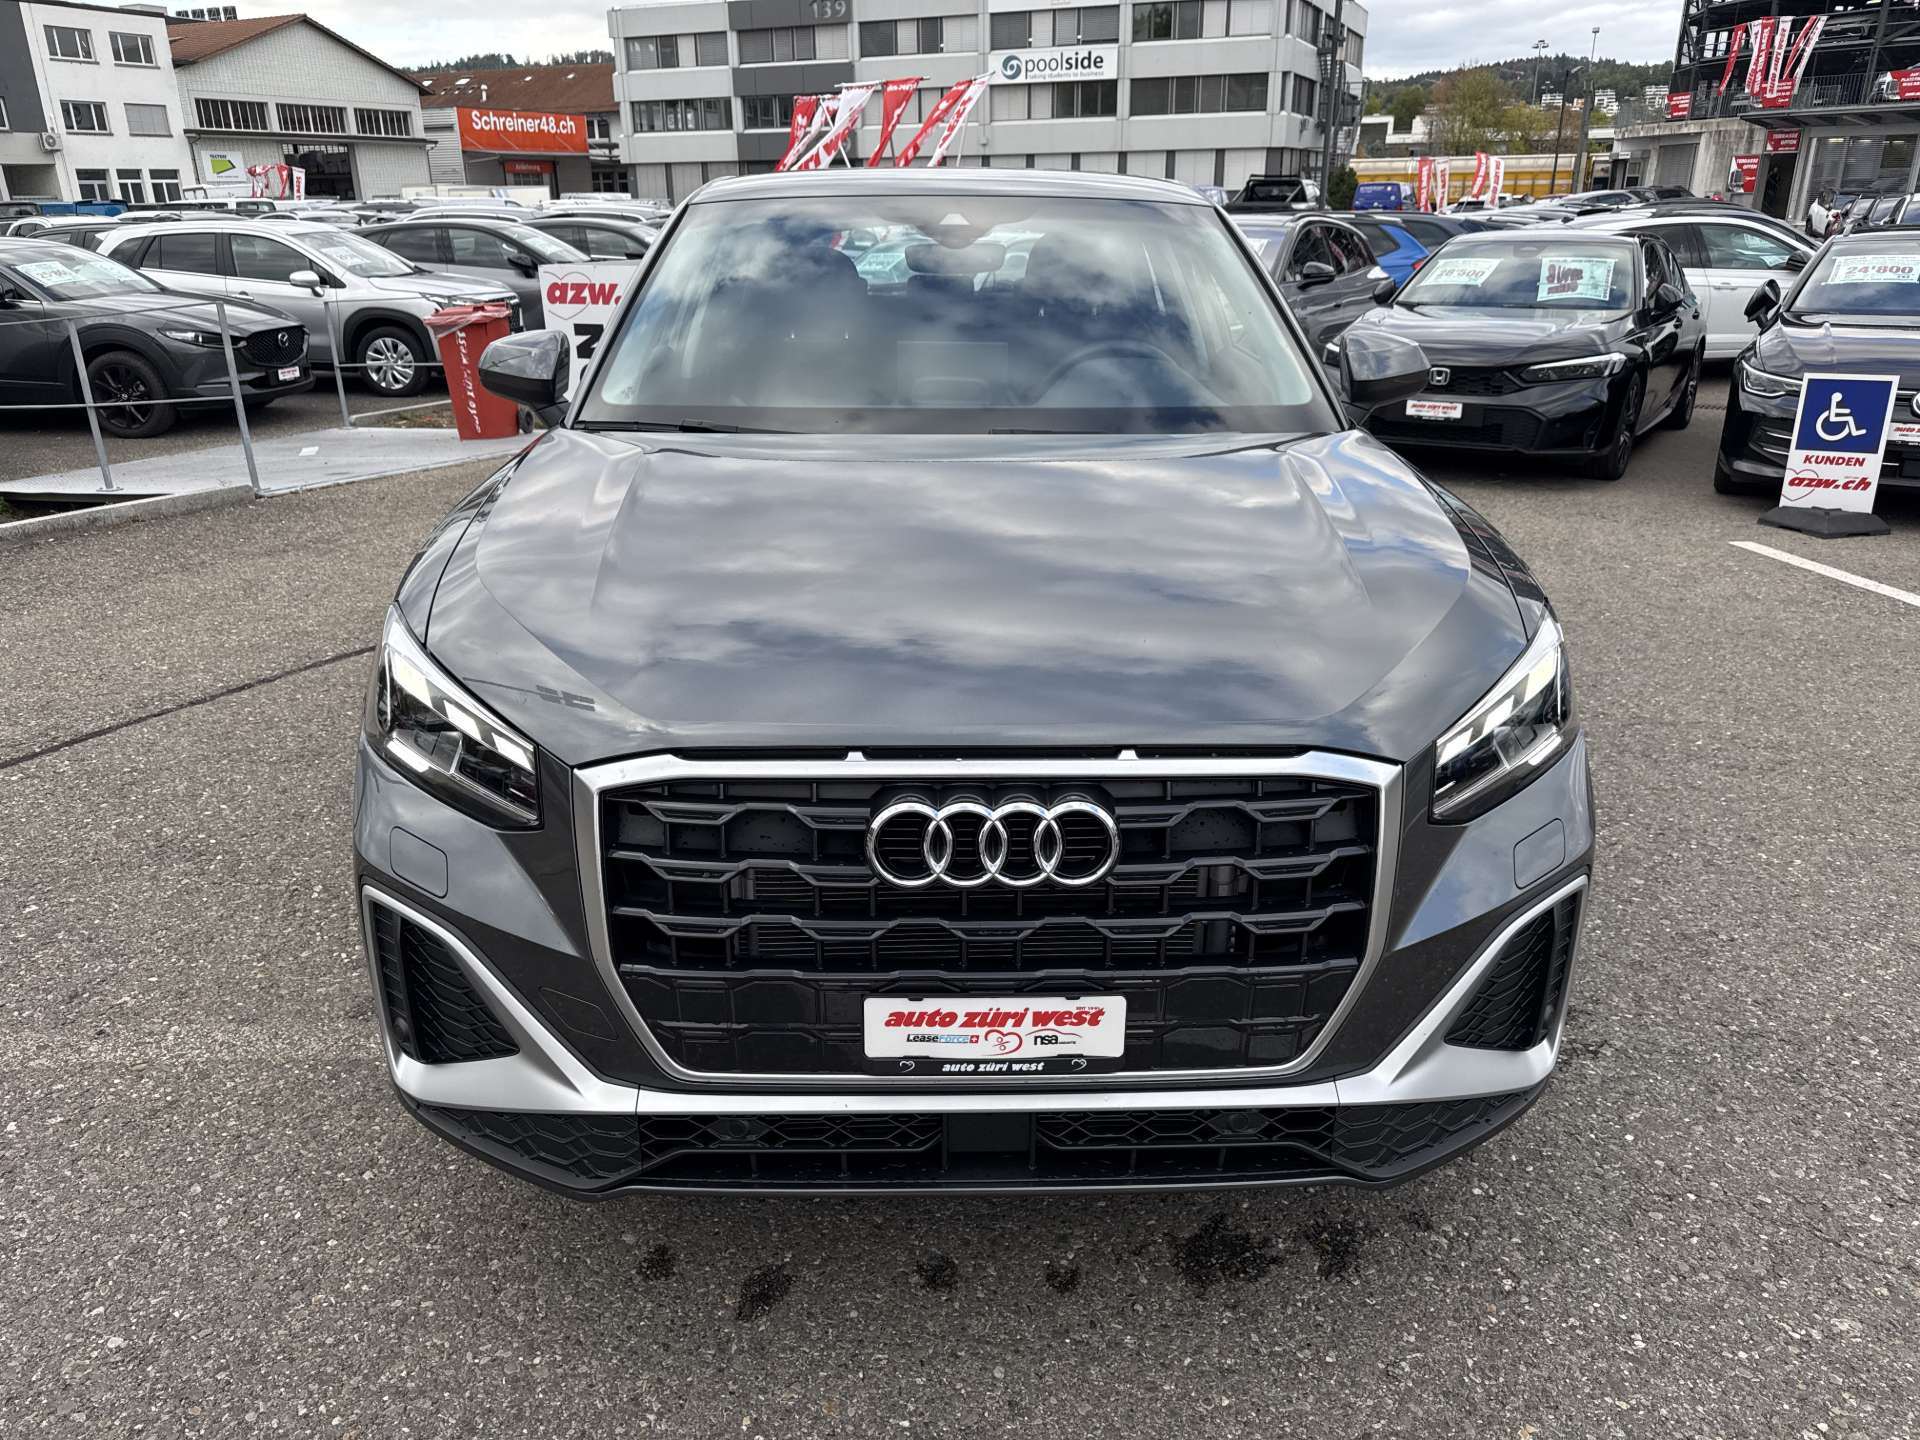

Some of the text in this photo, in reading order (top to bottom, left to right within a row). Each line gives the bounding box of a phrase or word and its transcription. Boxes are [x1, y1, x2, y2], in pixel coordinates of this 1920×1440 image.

[812, 0, 846, 18] 139
[1025, 51, 1104, 79] poolside
[471, 110, 576, 134] Schreiner48.ch
[1845, 265, 1914, 274] 24'800
[1803, 455, 1865, 467] KUNDEN
[1788, 477, 1871, 491] azw.ch
[884, 1008, 1105, 1028] auto züri west
[1034, 1035, 1058, 1045] nsa
[942, 1061, 1044, 1072] auto züri west
